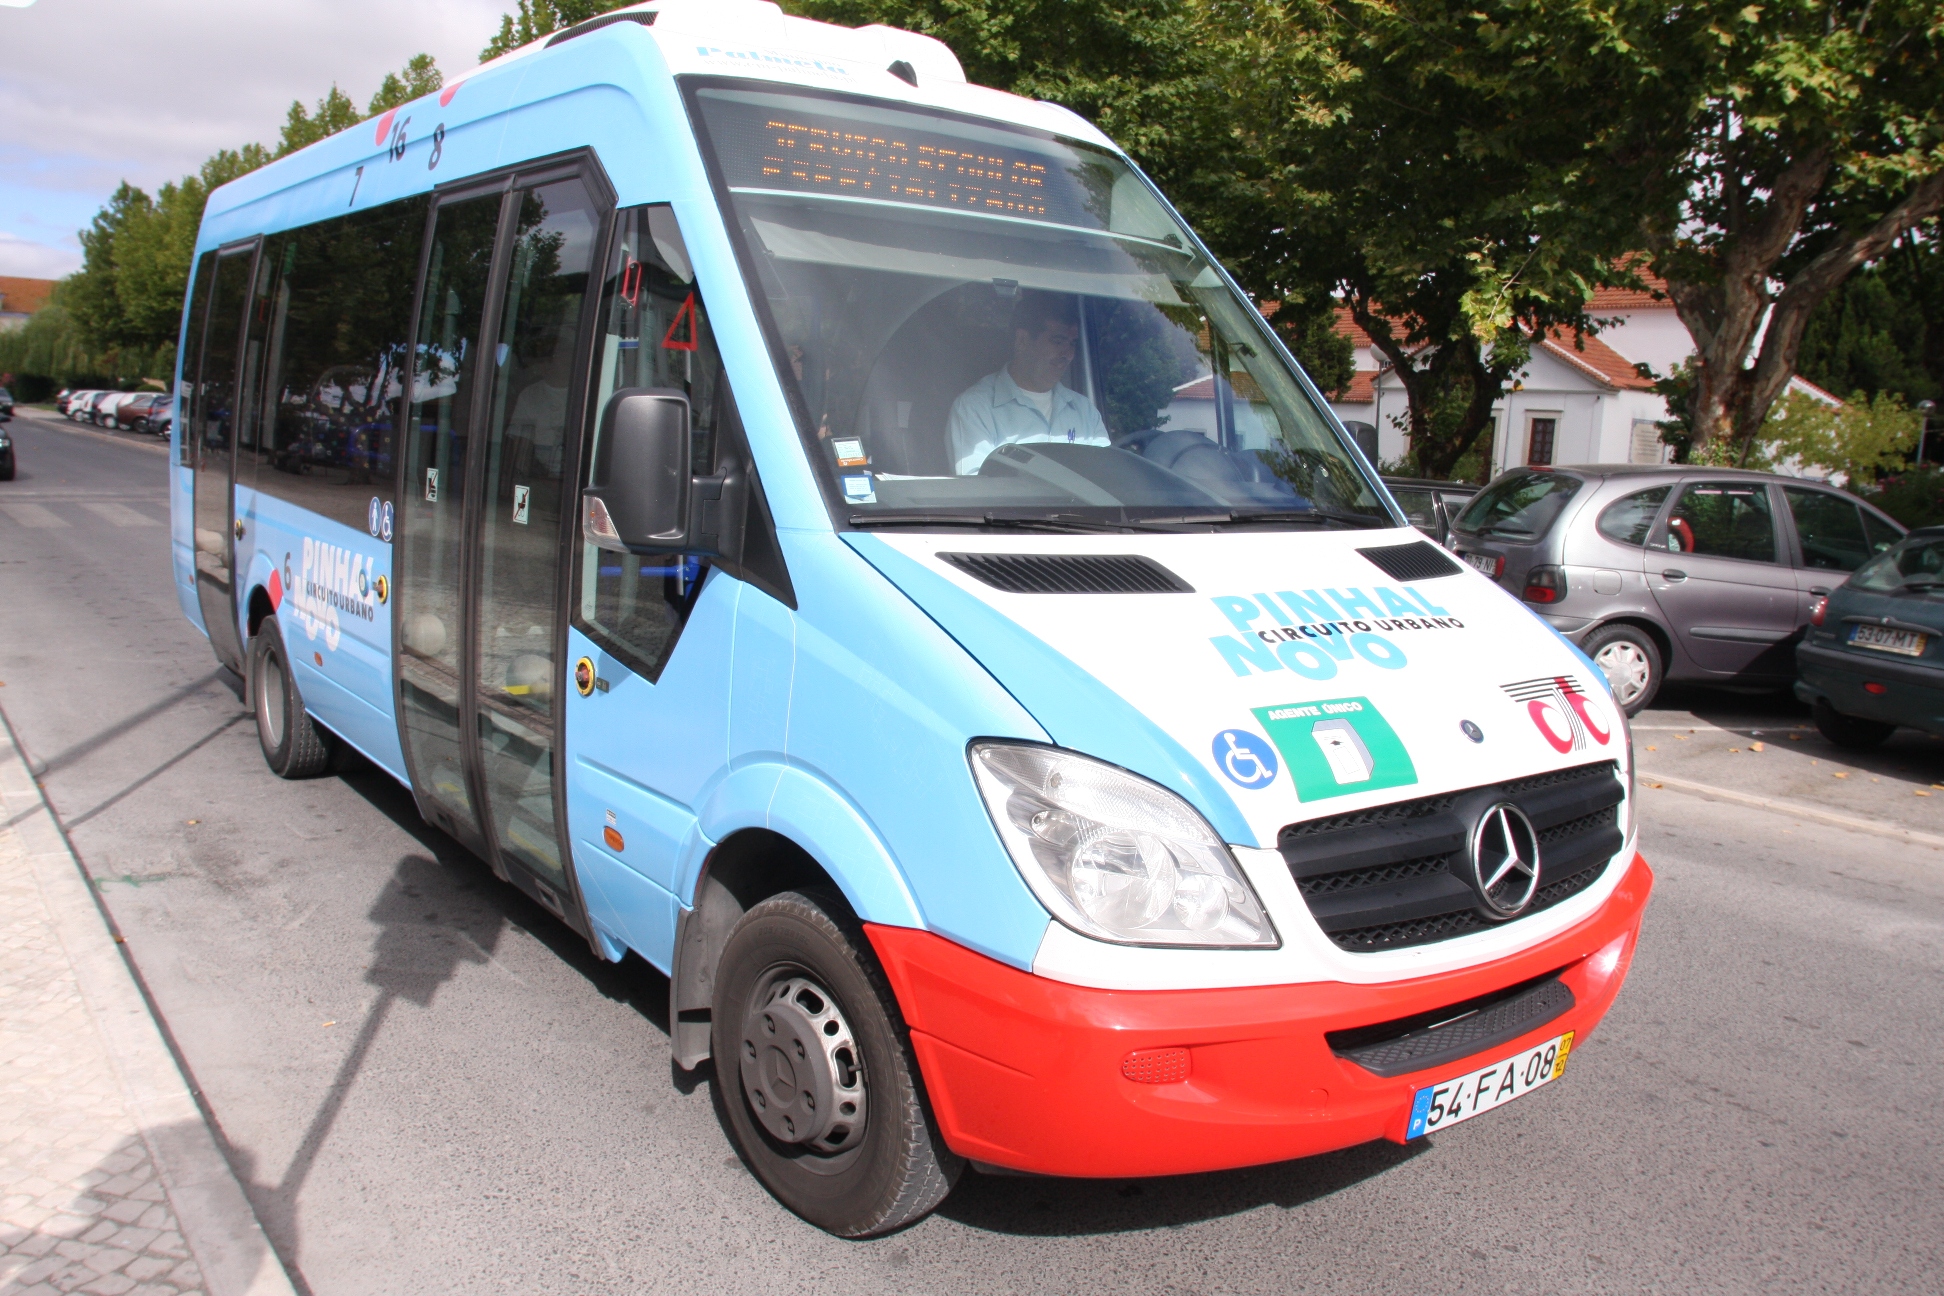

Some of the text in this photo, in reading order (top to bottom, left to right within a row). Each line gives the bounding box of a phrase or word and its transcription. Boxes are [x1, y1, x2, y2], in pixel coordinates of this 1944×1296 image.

[389, 115, 411, 163] 16
[428, 122, 445, 171] 8
[349, 165, 364, 207] 7
[283, 552, 292, 591] 6
[1209, 586, 1452, 632] PINHAL
[1258, 617, 1466, 644] CIRCUITO URBANO
[1208, 631, 1408, 681] NOVO
[1267, 705, 1322, 720] AGENTE
[1412, 1119, 1421, 1131] P
